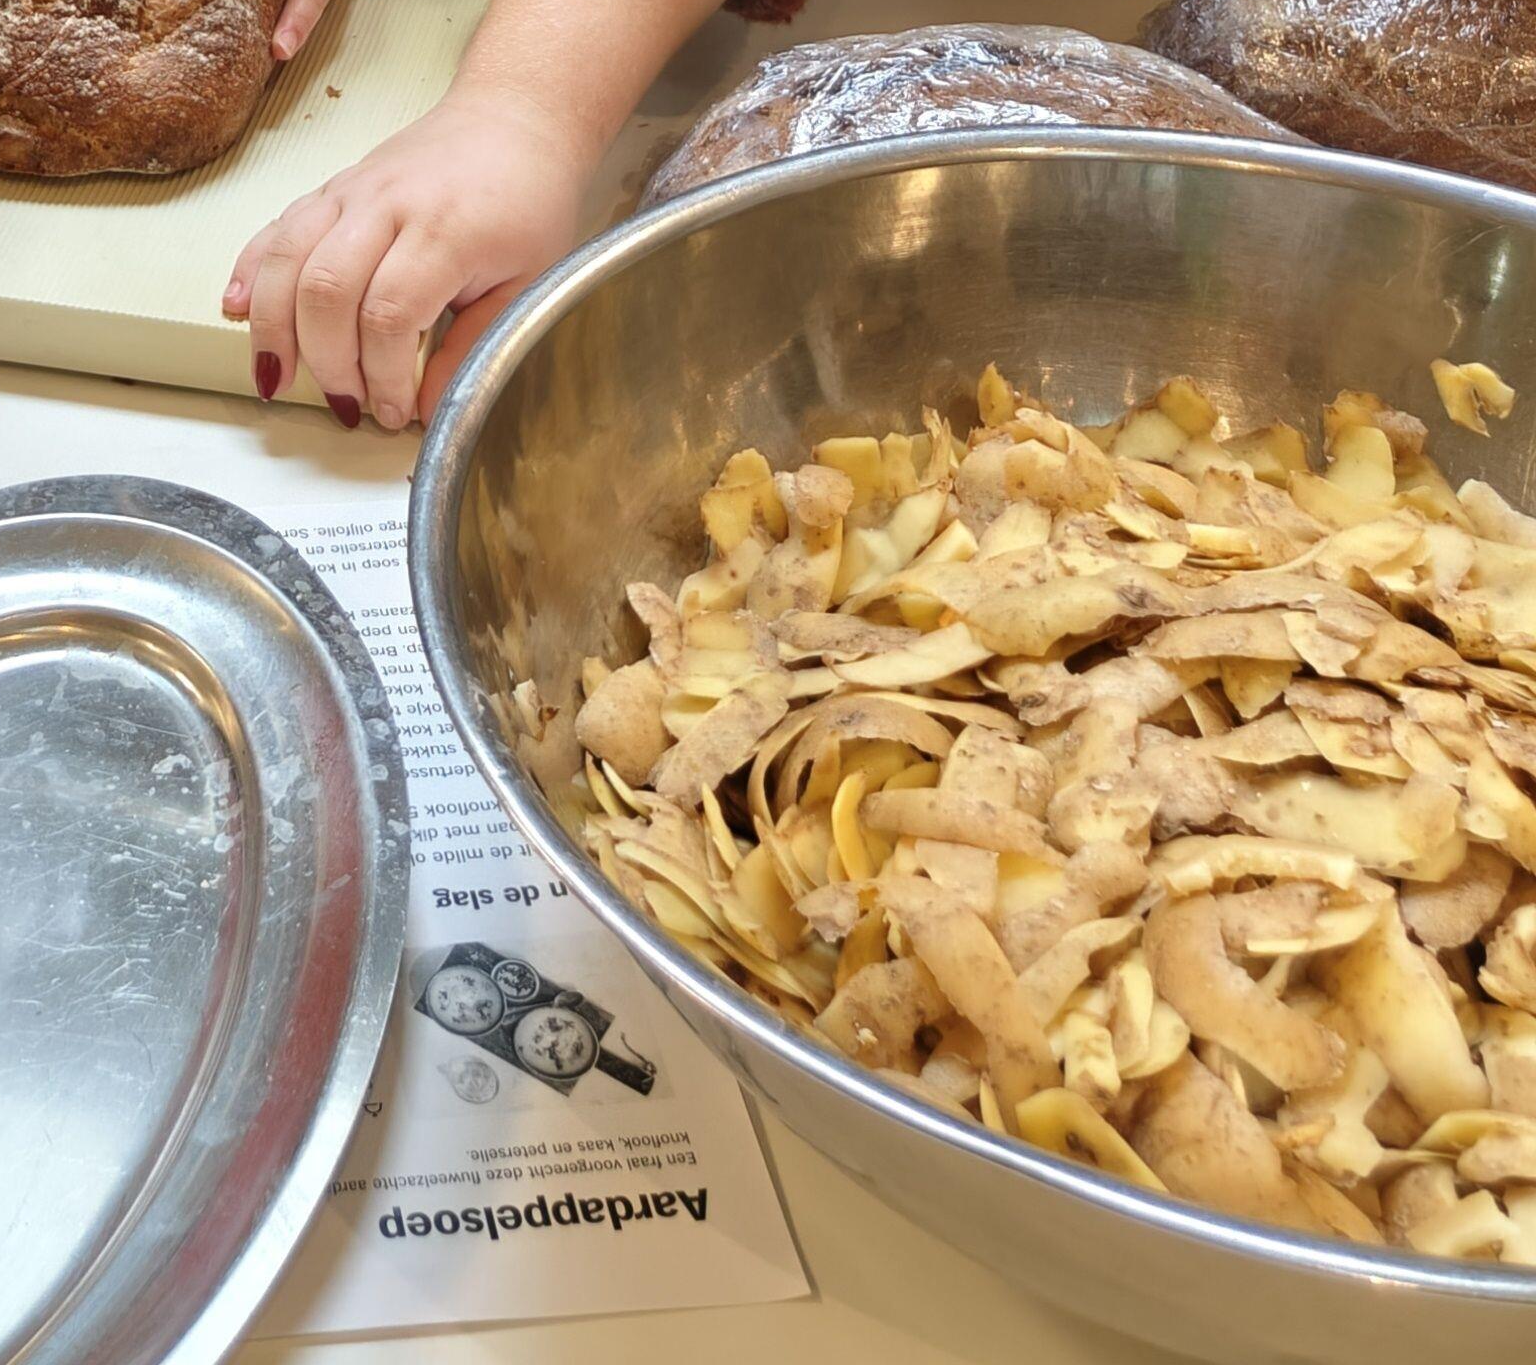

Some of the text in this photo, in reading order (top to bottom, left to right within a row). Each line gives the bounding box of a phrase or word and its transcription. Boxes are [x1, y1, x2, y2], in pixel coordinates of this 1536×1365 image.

[305, 546, 324, 557] en
[362, 557, 400, 570] soep
[381, 665, 414, 677] met
[423, 799, 501, 818] knoflook
[410, 827, 439, 843] dik
[443, 824, 480, 840] met
[489, 846, 513, 862] de
[432, 887, 494, 910] slag
[503, 885, 540, 906] de
[552, 1142, 572, 1155] en
[577, 1139, 614, 1152] kaas
[618, 1131, 691, 1151] knoflook,
[666, 1151, 697, 1165] Een
[485, 1167, 523, 1182] deze
[528, 1159, 622, 1179] voorgerecht
[372, 1170, 481, 1191] fluweelzachte
[378, 1188, 709, 1241] Aardappelsoep
